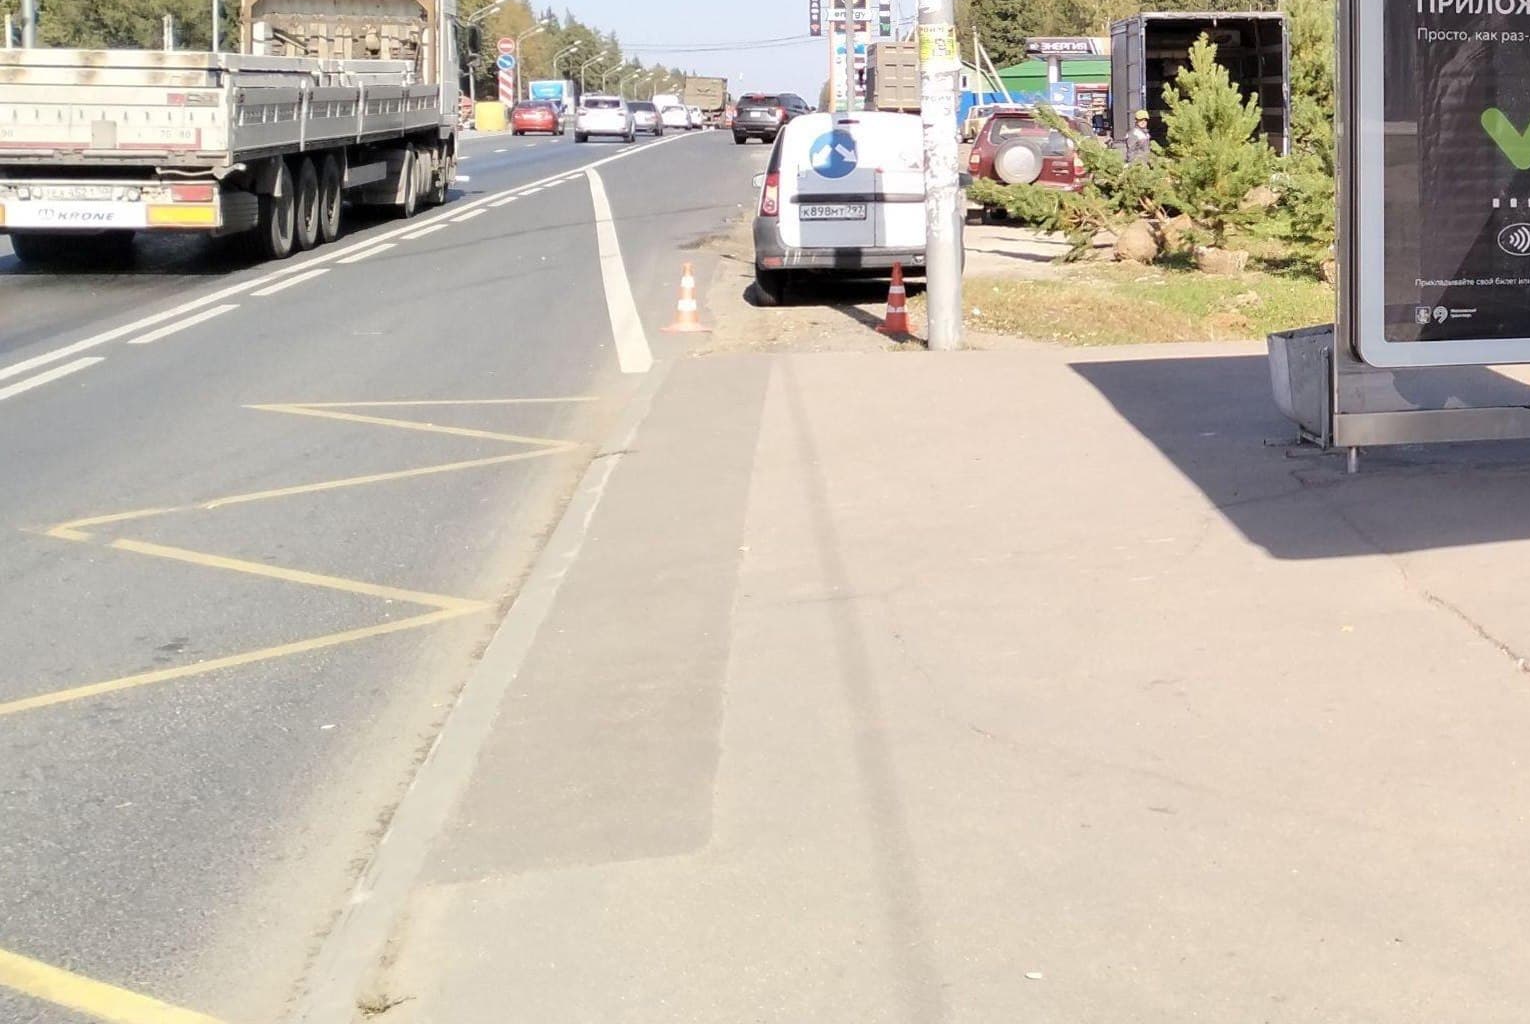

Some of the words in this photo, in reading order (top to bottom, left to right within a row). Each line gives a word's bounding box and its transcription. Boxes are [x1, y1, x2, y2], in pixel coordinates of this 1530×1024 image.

[834, 11, 866, 19] engy
[1417, 27, 1472, 43] Просто,
[1475, 31, 1498, 41] как
[1041, 42, 1088, 51] ЭНЕРГИЯ
[57, 211, 116, 221] KRONE
